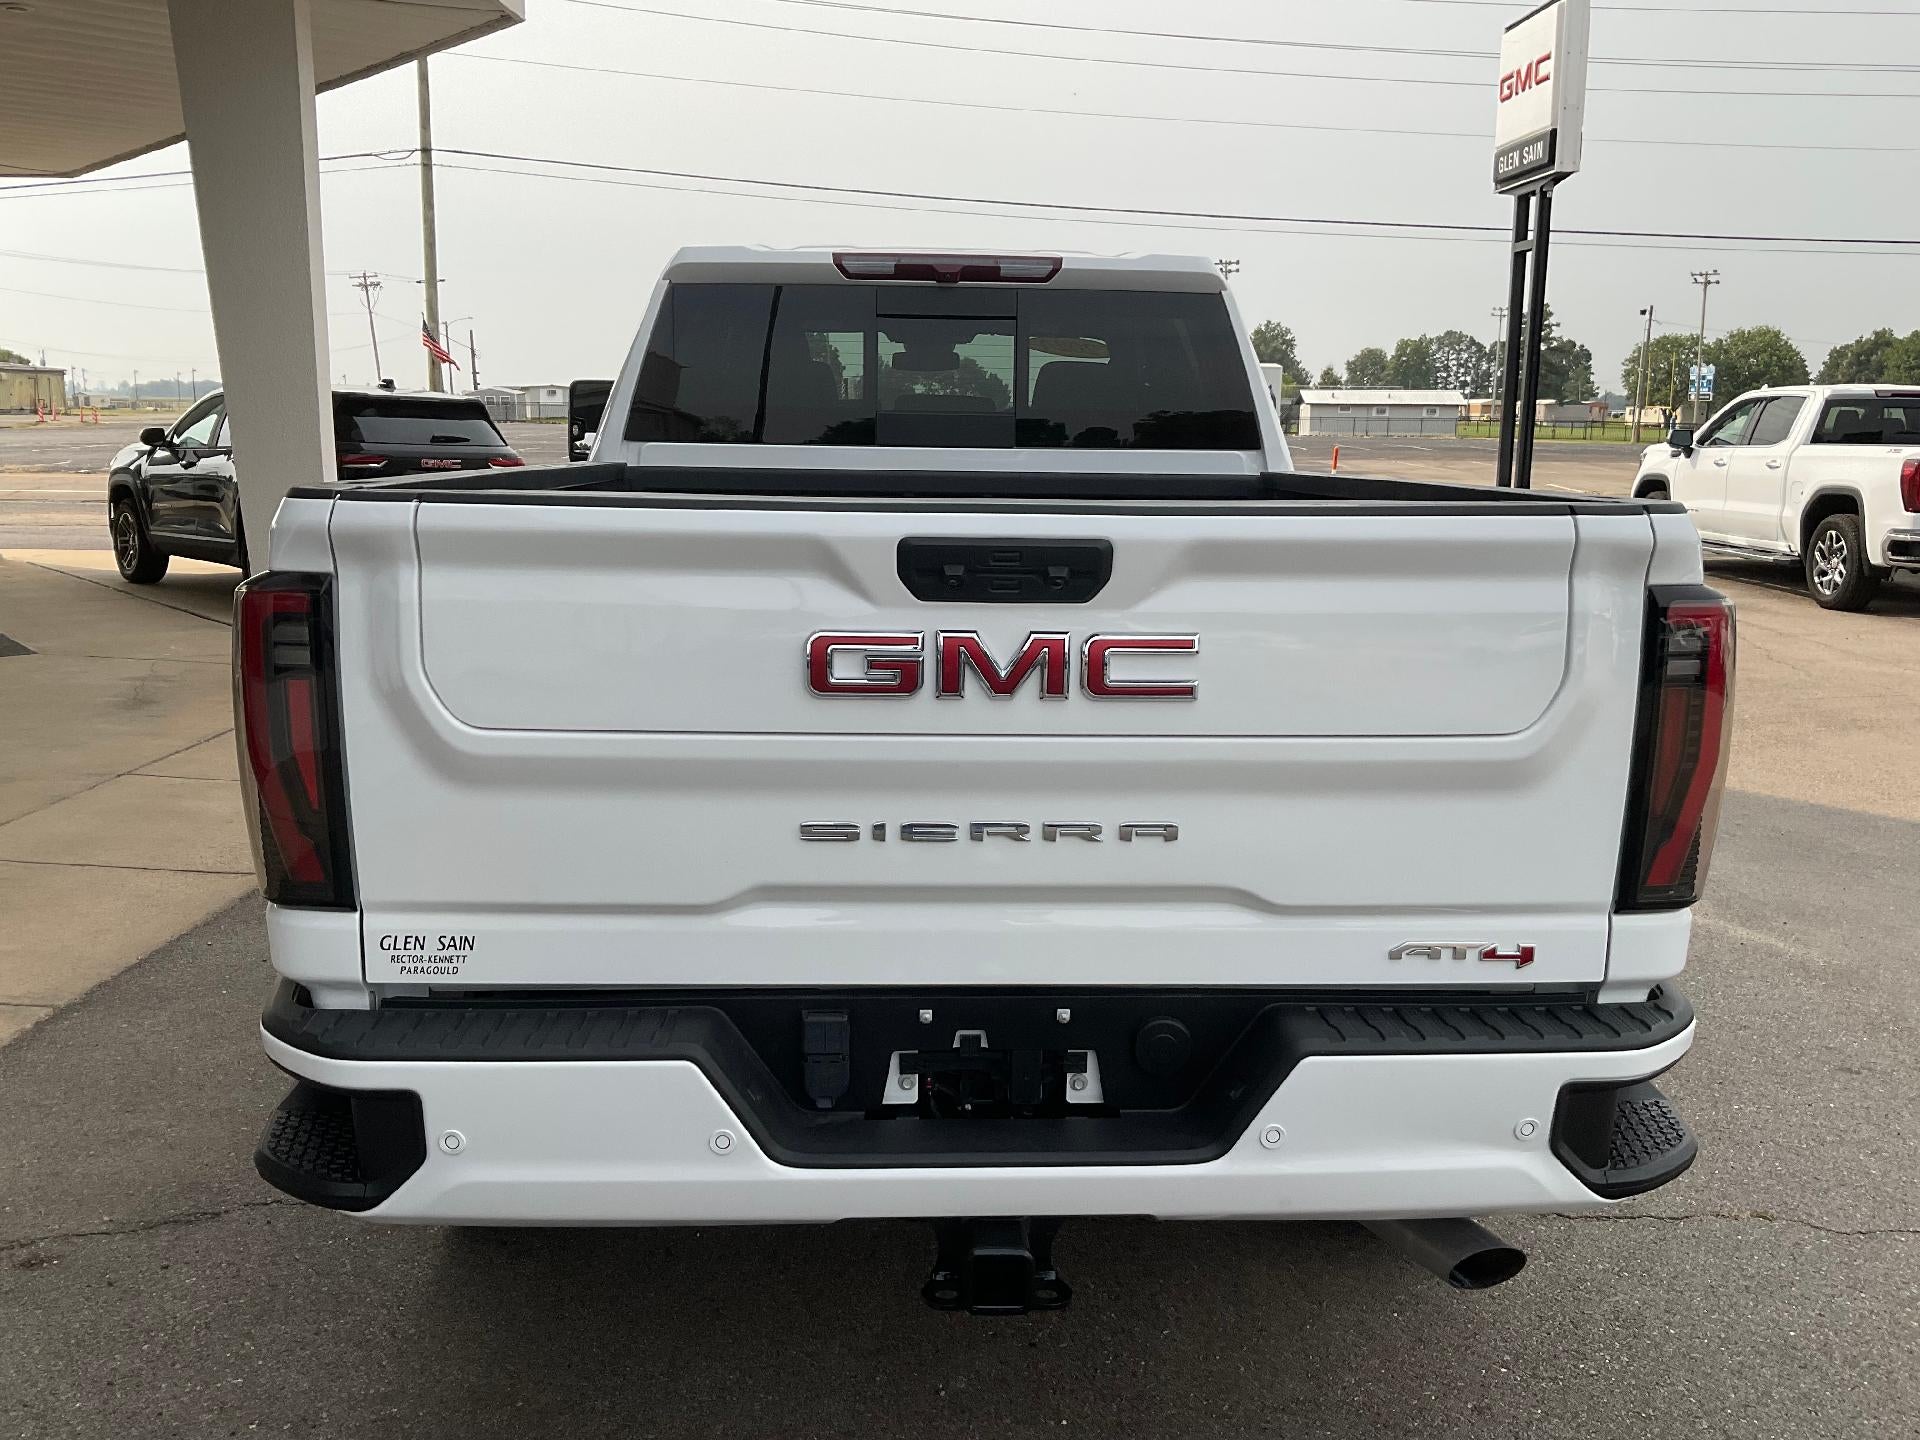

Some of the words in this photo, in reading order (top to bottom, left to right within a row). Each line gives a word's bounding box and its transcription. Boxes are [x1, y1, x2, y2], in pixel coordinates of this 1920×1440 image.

[1499, 51, 1551, 103] GMC
[1498, 150, 1520, 174] GLEN
[1522, 141, 1544, 164] SAIN
[421, 459, 461, 468] GMC
[805, 630, 1200, 701] GMC
[800, 820, 1179, 843] SIERRA
[379, 934, 426, 951] GLEN
[436, 935, 475, 951] SAIN
[390, 954, 468, 964] RECTOR-KENNETT
[1388, 941, 1537, 969] AT4
[399, 965, 459, 975] PARAGOULD
